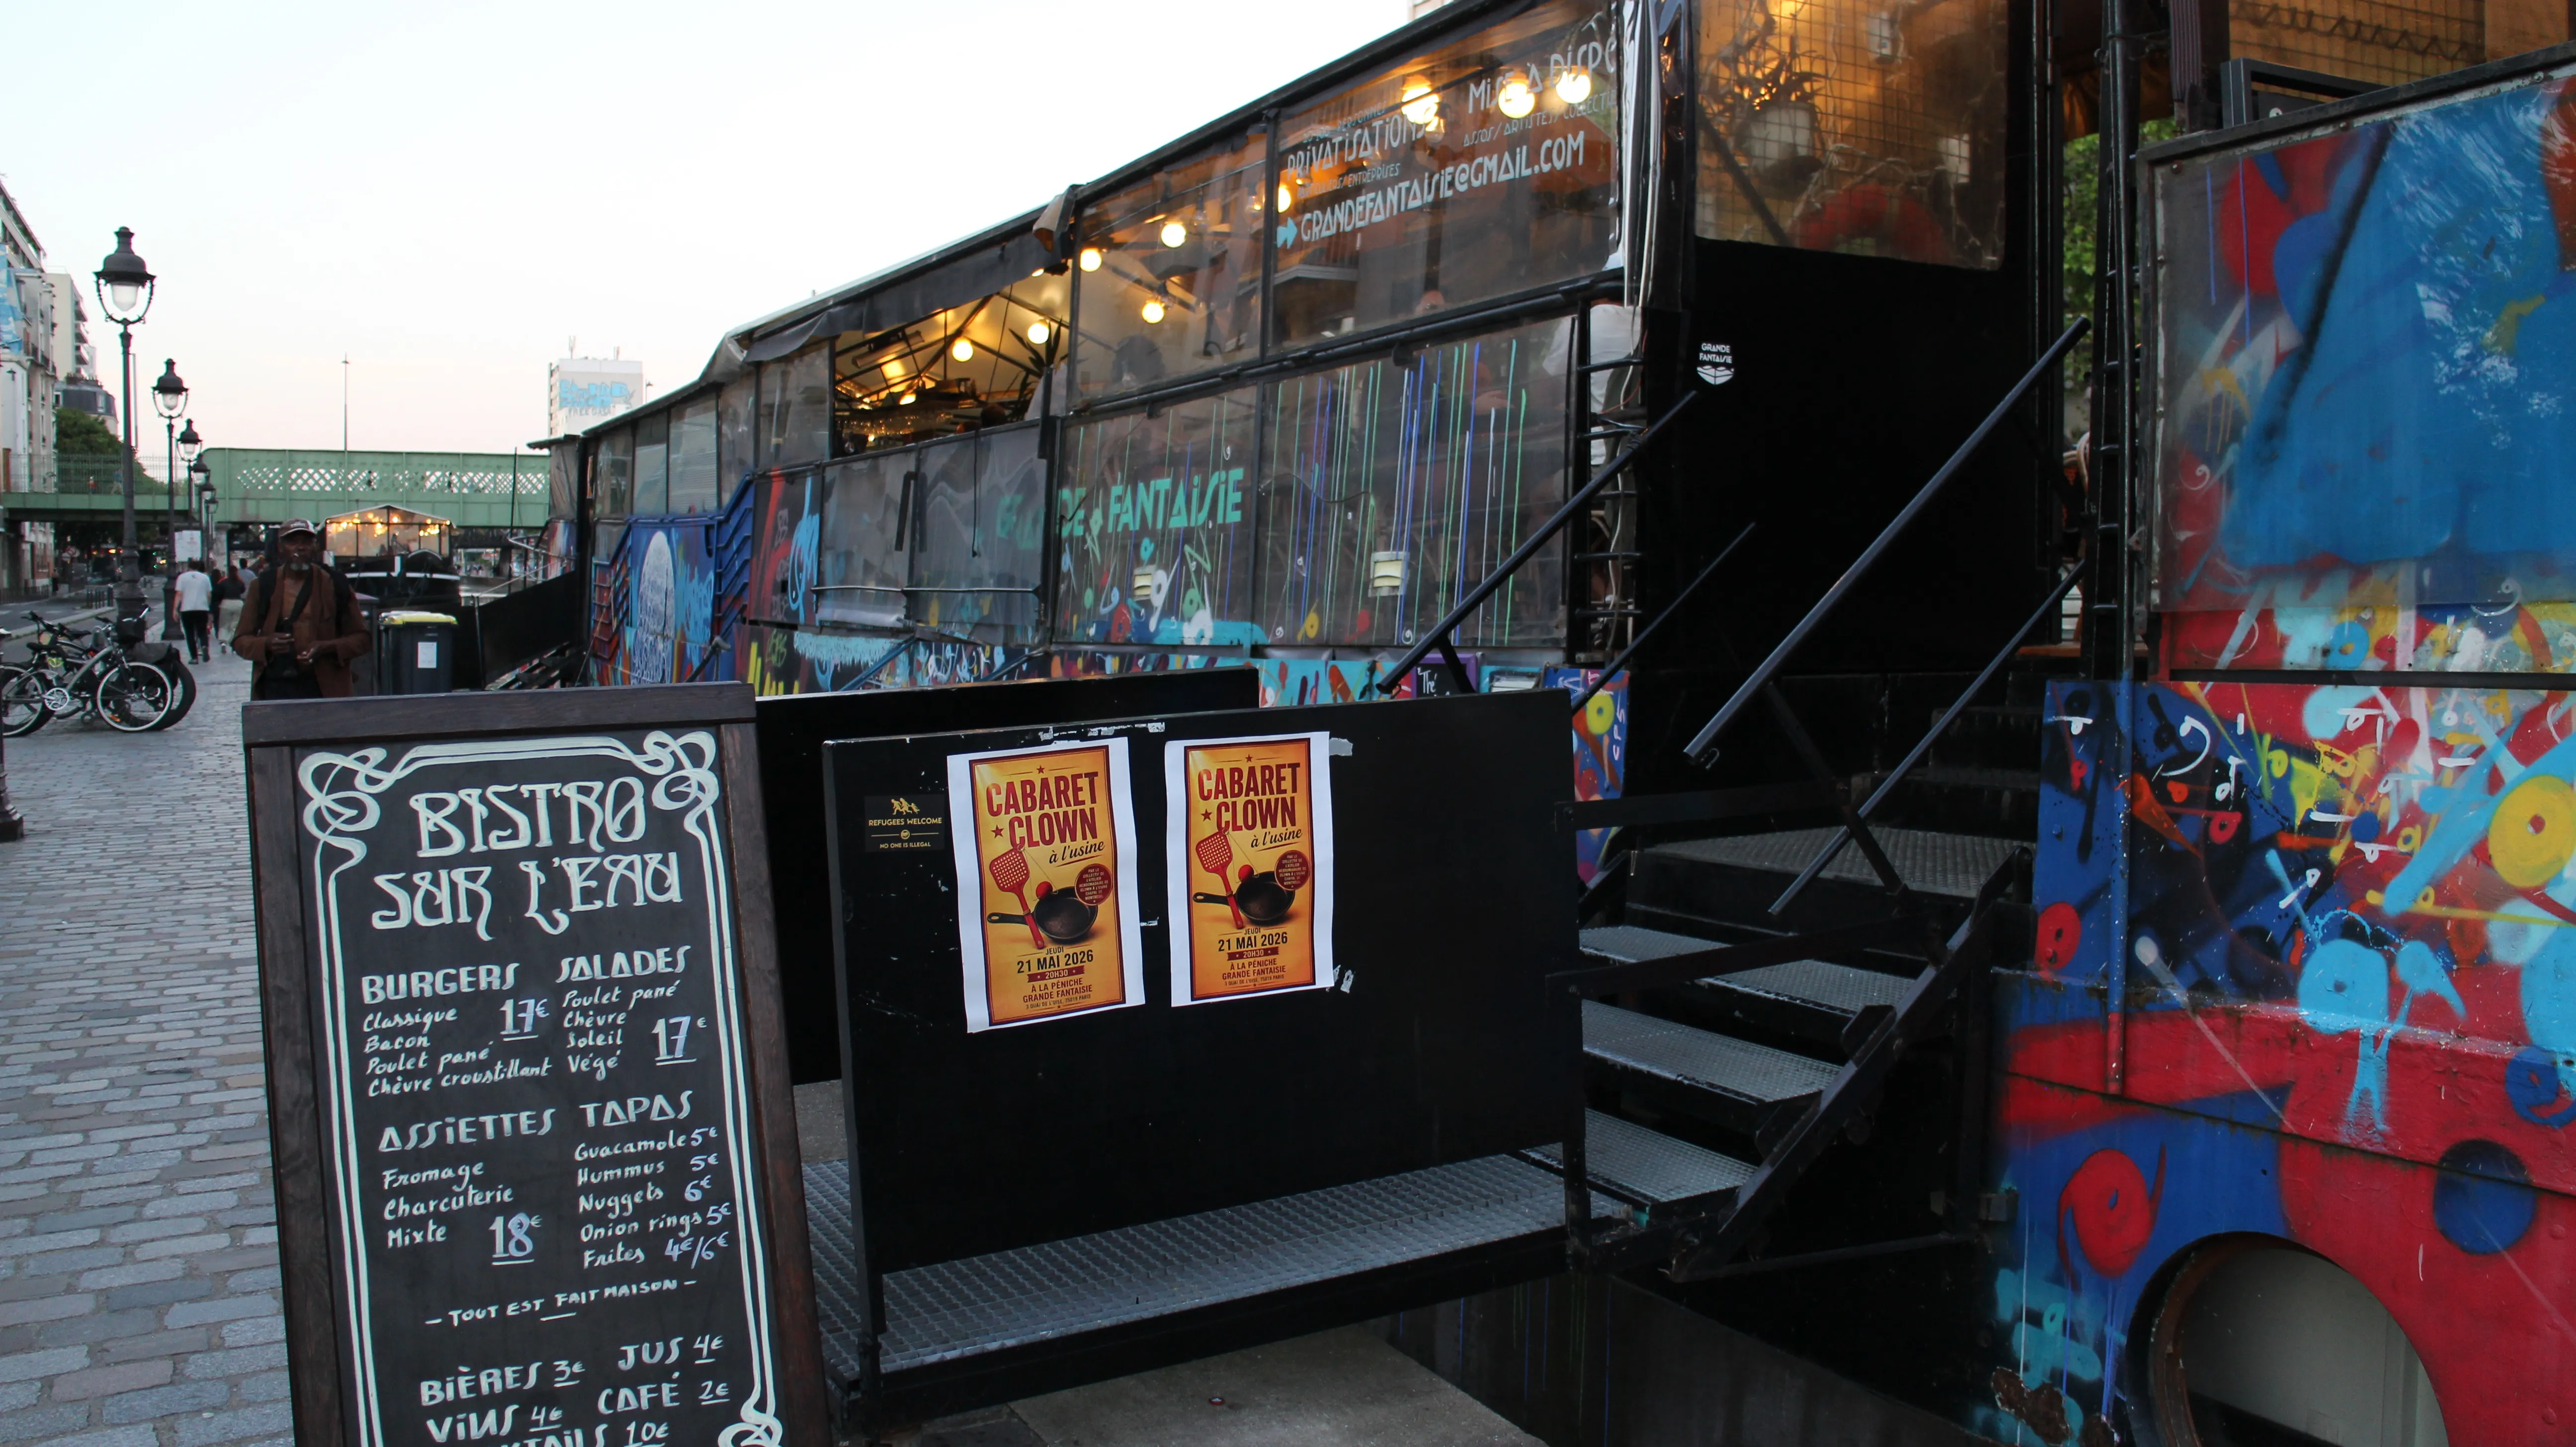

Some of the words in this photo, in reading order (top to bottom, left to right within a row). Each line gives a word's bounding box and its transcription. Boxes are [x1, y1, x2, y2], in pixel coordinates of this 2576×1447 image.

[1699, 353, 1732, 364] FANTAISIE
[1701, 343, 1730, 353] GRANDE
[1107, 468, 1244, 533] FANTAISIE
[1417, 667, 1438, 694] Thé
[986, 771, 1099, 817] CABARET
[1198, 762, 1301, 802] CABARET
[409, 776, 646, 858] BISTRO
[1008, 807, 1098, 850] CLOWN
[1216, 796, 1296, 833] CLOWN
[1048, 849, 1058, 864] à
[1061, 841, 1106, 862] l'usine
[1250, 834, 1259, 848] à
[1262, 828, 1302, 846] l'usine
[371, 865, 495, 942] SUR
[518, 851, 684, 935] L'EAU
[1046, 946, 1064, 955] JEUDI
[1218, 939, 1231, 952] 21
[1236, 935, 1257, 950] MAI
[1261, 932, 1288, 947] 2026
[1243, 949, 1264, 958] 20H30
[555, 945, 692, 983] SALADES
[1017, 960, 1031, 974] 21
[1037, 955, 1060, 970] MAI
[1064, 949, 1094, 966] 2026
[1045, 969, 1068, 979] 20H30
[1222, 970, 1251, 980] GRANDE
[1253, 965, 1287, 977] FANTAISIE
[1230, 962, 1235, 971] À
[1248, 958, 1277, 968] PÉNICHE
[361, 962, 520, 1005] BURGERS
[562, 986, 622, 1008] Poulet
[628, 979, 681, 1011] pané
[1023, 991, 1054, 1003] GRANDE
[1056, 984, 1093, 998] FANTAISIE
[1031, 984, 1037, 993] À
[1039, 983, 1048, 992] LA
[1051, 977, 1083, 990] PÉNICHE
[362, 1008, 458, 1035] Classique
[563, 1010, 627, 1028] Chèvre
[363, 1034, 431, 1054] Bacon
[565, 1028, 623, 1048] Soleil
[366, 1050, 429, 1075] Poulet
[437, 1041, 494, 1075] pané
[566, 1049, 621, 1081] Végé
[368, 1075, 433, 1097] Chèvre
[440, 1056, 553, 1088] croustillant
[578, 1090, 694, 1127] TAPAS
[574, 1129, 687, 1161] Guacamole
[690, 1126, 719, 1147] 5€
[381, 1161, 484, 1193] Fromage
[576, 1160, 665, 1187] Hummus
[689, 1153, 719, 1172] 5€
[383, 1184, 514, 1221] Charcuterie
[578, 1181, 664, 1219] Nuggets
[684, 1174, 713, 1203] 6€
[387, 1217, 447, 1249] Mixte
[579, 1221, 640, 1243] Onion
[648, 1211, 703, 1238] rings
[706, 1202, 732, 1226] 5€
[582, 1241, 645, 1270] Frites
[448, 1304, 500, 1327] TOUT
[505, 1298, 545, 1317] EST
[555, 1288, 600, 1308] FAIT
[603, 1278, 678, 1301] MAISON
[617, 1337, 684, 1371] JUS
[692, 1334, 724, 1359] 4€
[552, 1360, 586, 1382] 3€
[597, 1371, 681, 1415] CAFÉ
[698, 1379, 729, 1401] 2€
[529, 1405, 563, 1428] 4€
[625, 1421, 670, 1446] 10€
